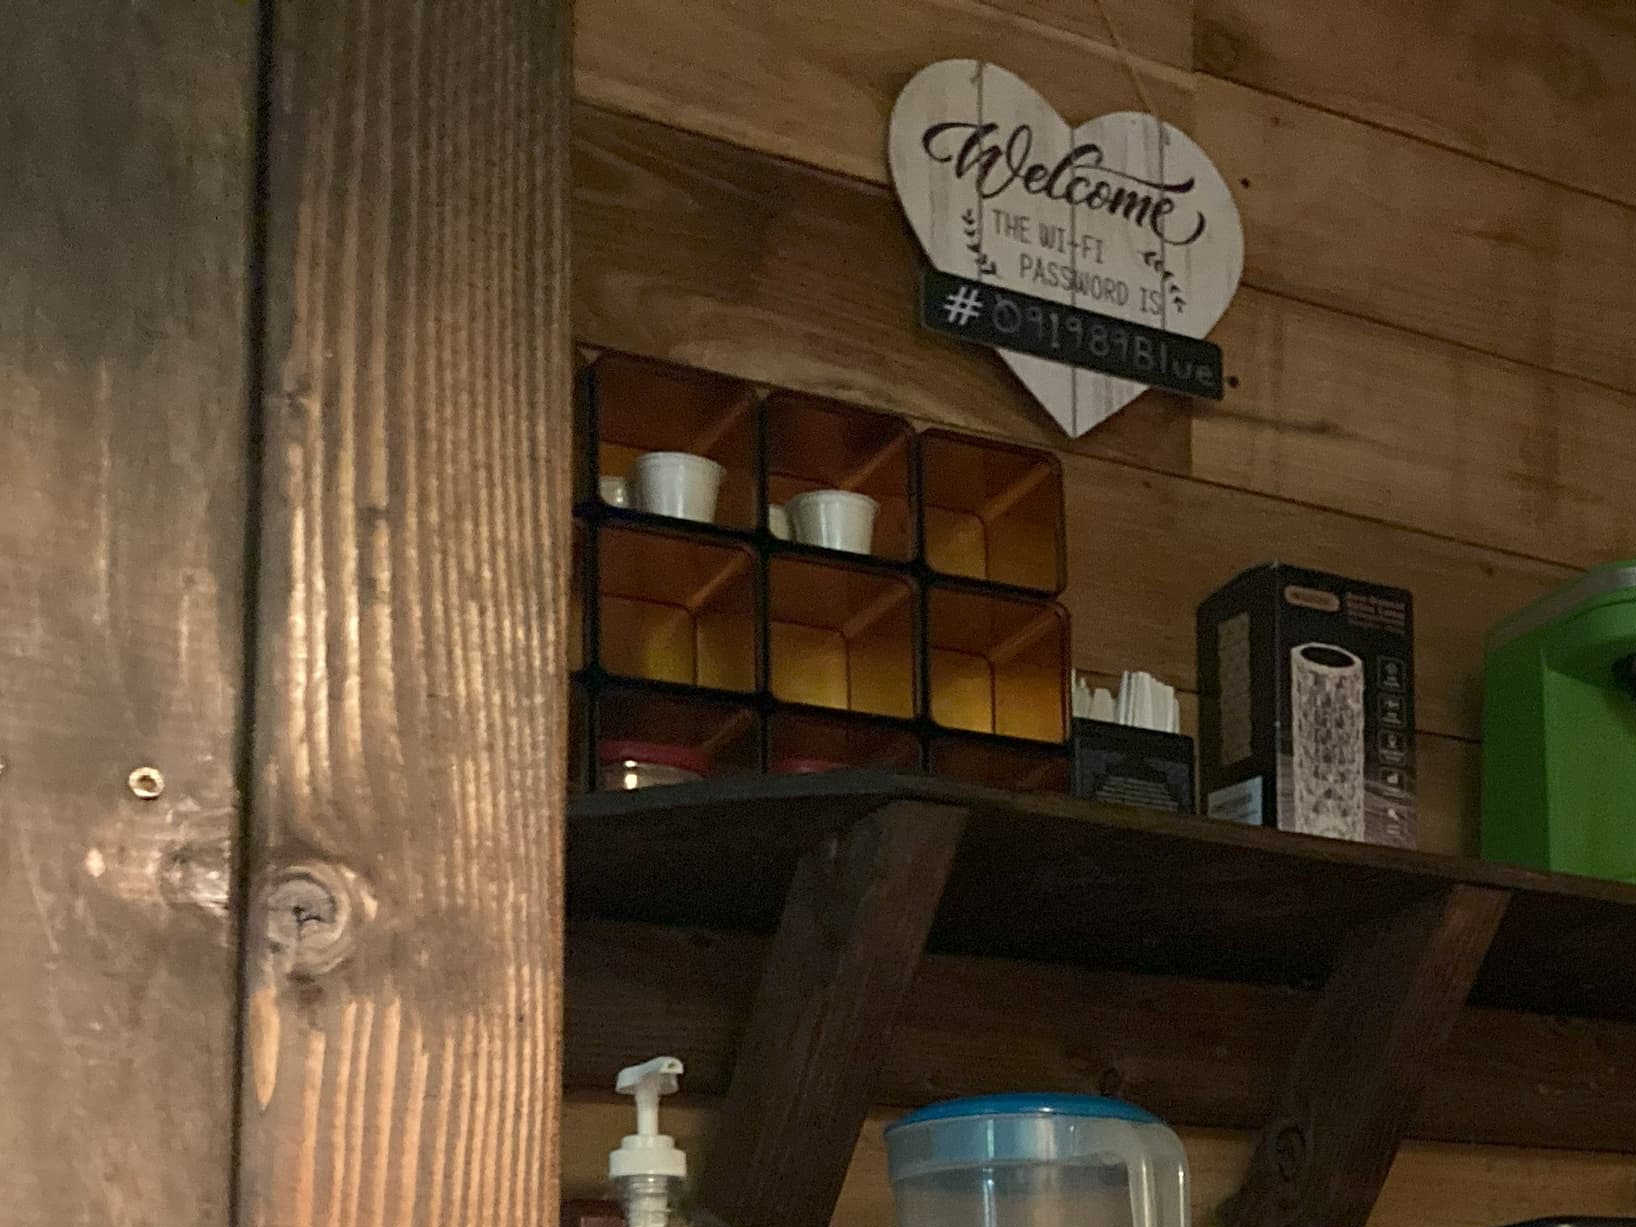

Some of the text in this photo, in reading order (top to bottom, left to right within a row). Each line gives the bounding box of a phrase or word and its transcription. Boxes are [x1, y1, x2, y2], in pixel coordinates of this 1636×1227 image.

[922, 122, 1206, 246] Welcome
[992, 209, 1104, 264] THE WI-FI
[1019, 253, 1163, 316] PASSWORD IS
